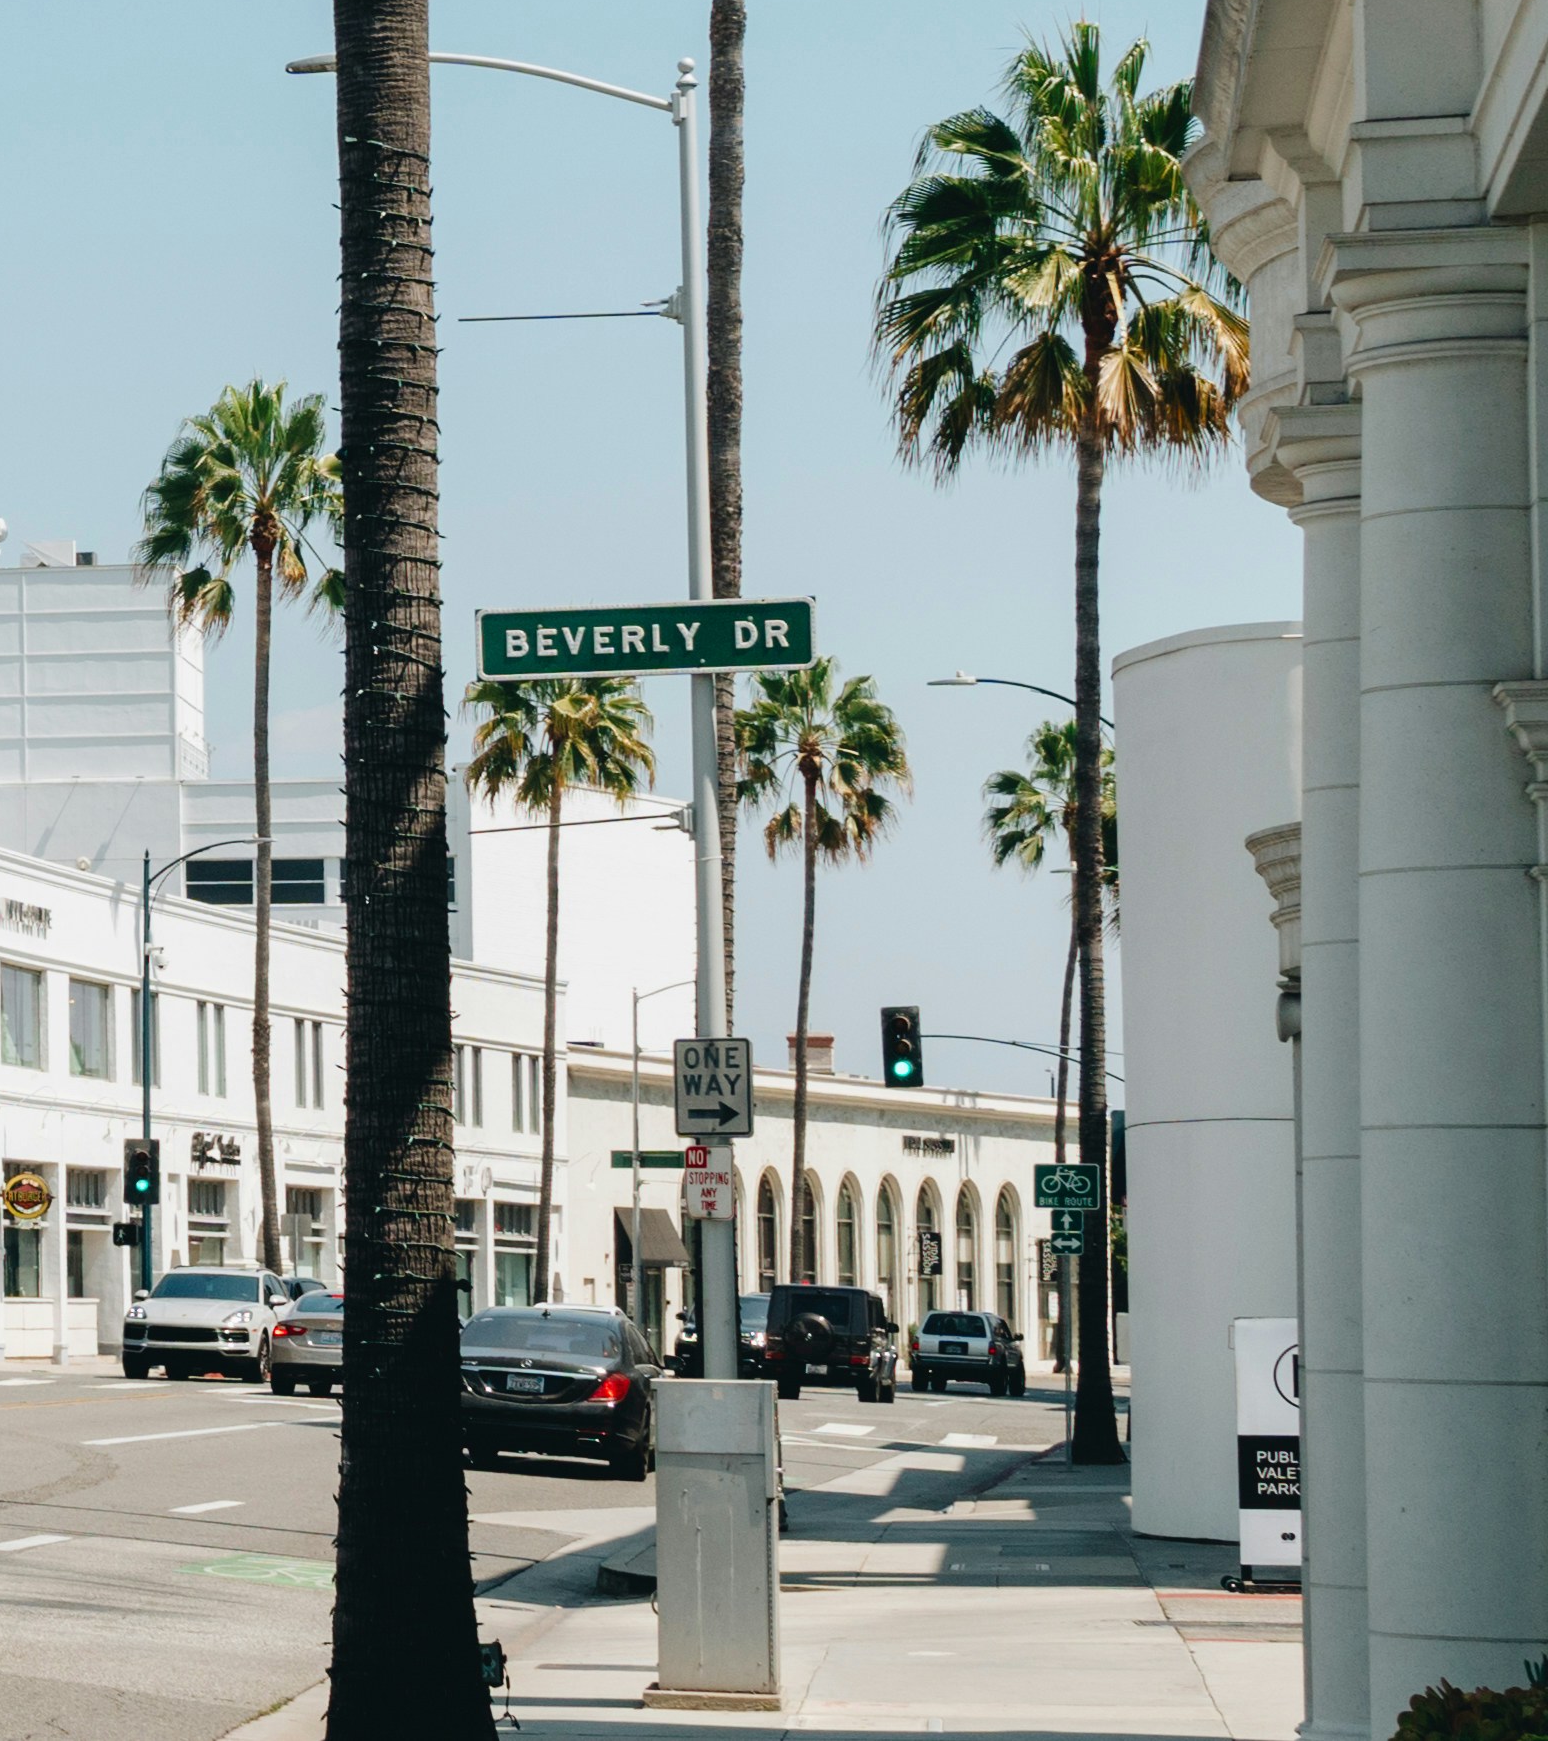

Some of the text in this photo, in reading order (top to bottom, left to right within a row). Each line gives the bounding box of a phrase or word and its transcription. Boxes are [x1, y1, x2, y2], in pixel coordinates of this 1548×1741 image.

[506, 619, 789, 658] BEVERLY DR
[683, 1047, 739, 1069] ONE
[683, 1074, 741, 1096] WAY
[688, 1150, 704, 1166] NO
[688, 1172, 729, 1185] STOPPING
[700, 1188, 717, 1198] ANY
[701, 1200, 717, 1210] TIME
[1039, 1197, 1093, 1207] BIKE ROUTE
[1256, 1451, 1299, 1464] PUBL
[1257, 1467, 1301, 1479] VALE
[1258, 1482, 1301, 1495] PARK
